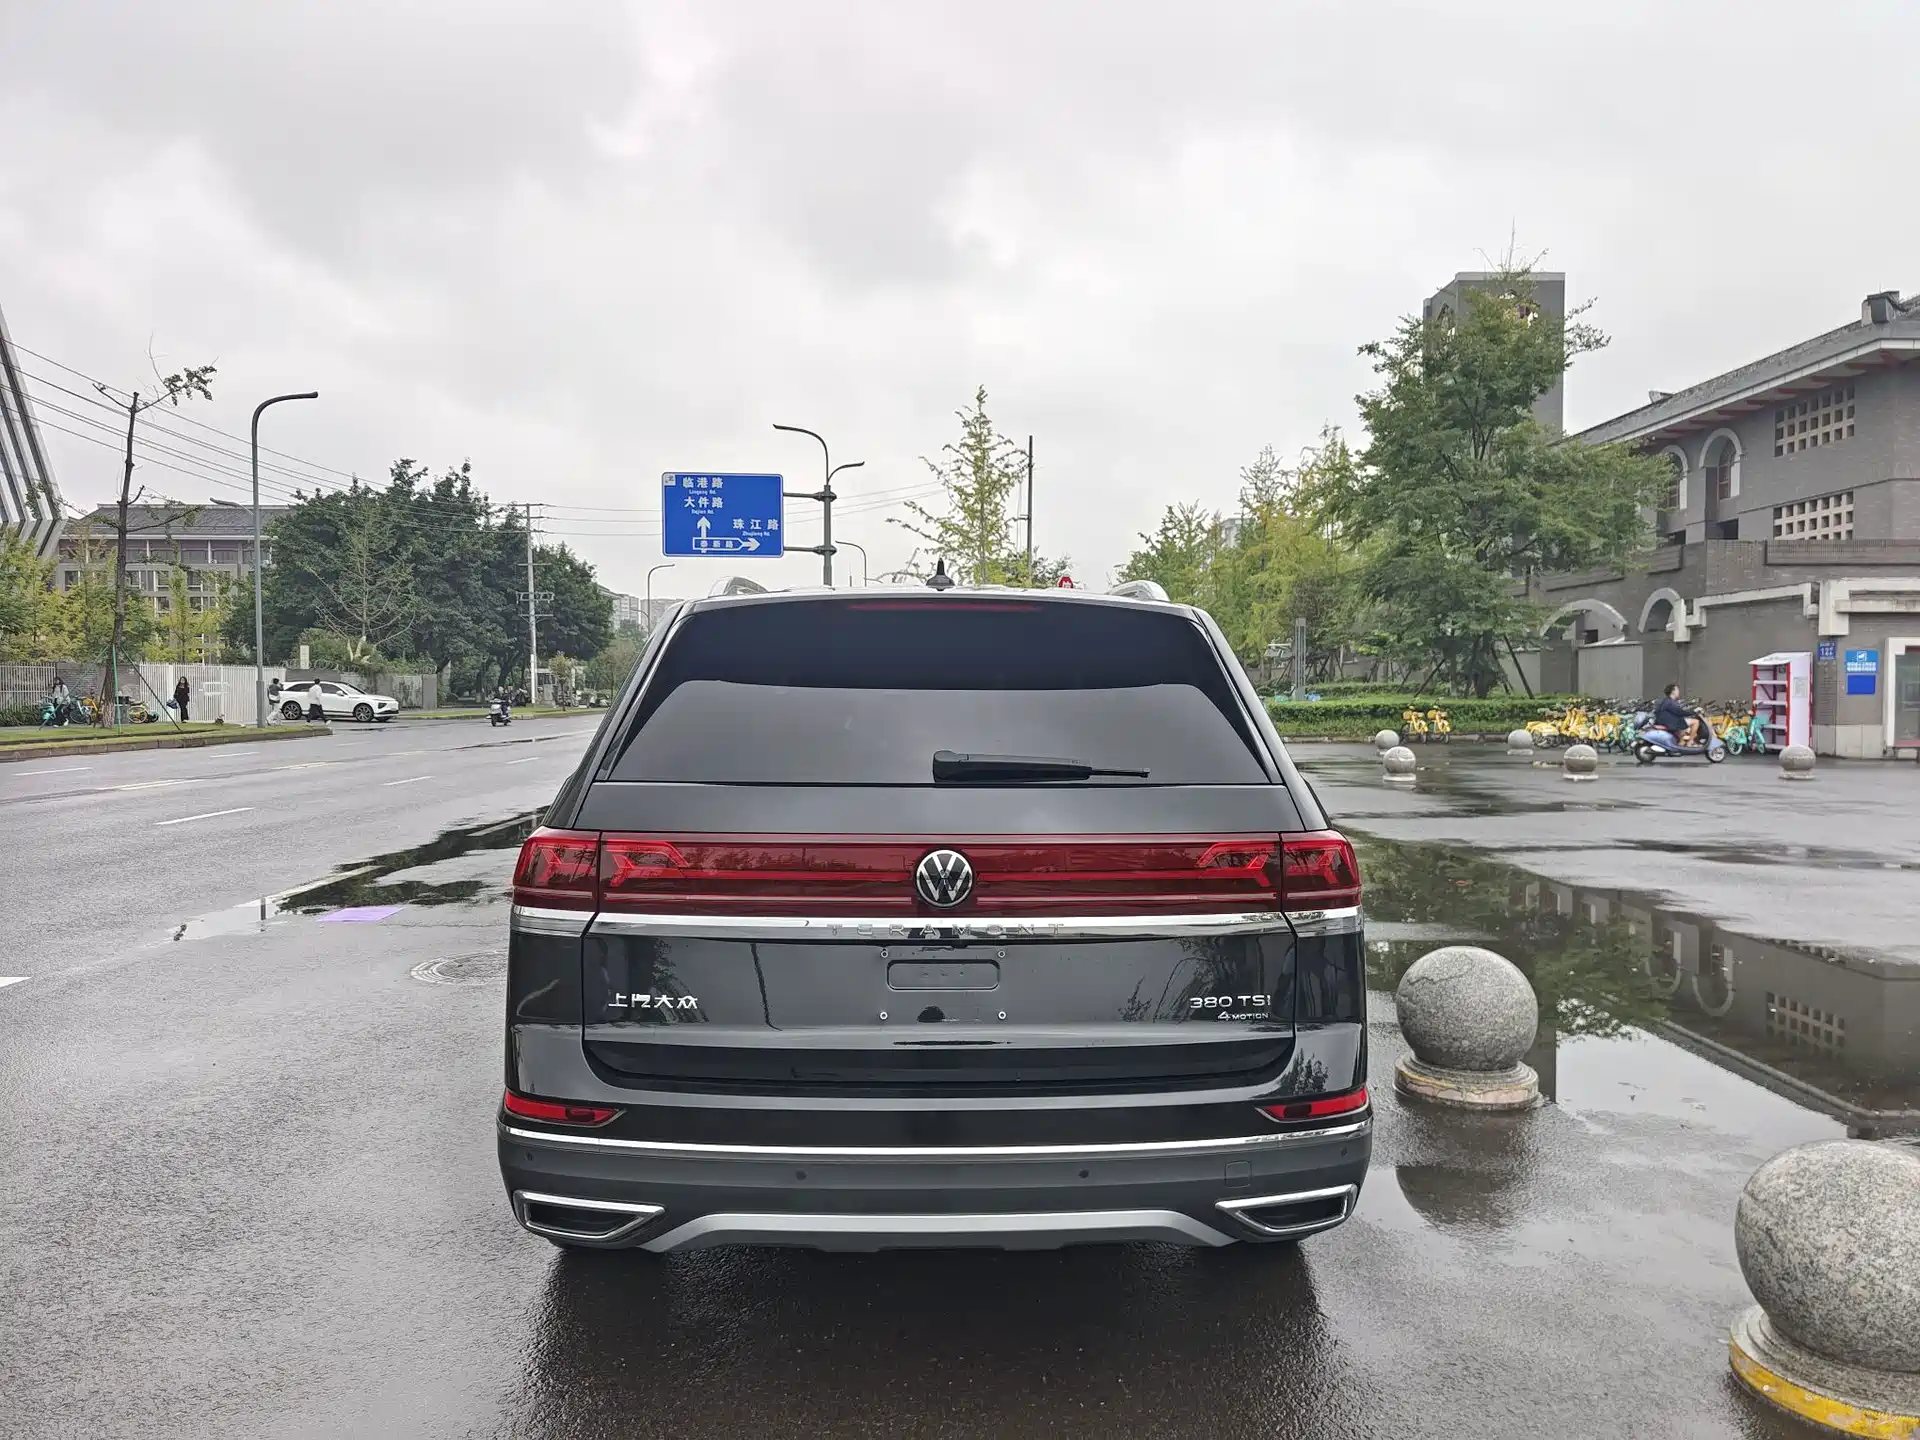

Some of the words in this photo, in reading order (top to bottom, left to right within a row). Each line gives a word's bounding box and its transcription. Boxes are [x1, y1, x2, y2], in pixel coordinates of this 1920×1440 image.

[682, 477, 723, 488] 临港路
[684, 496, 723, 508] 大件路
[732, 518, 779, 530] 珠江路
[826, 923, 1065, 936] TERAMONT
[608, 992, 698, 1009] 上汽大众
[1189, 996, 1232, 1008] 380
[1237, 994, 1271, 1006] TSI
